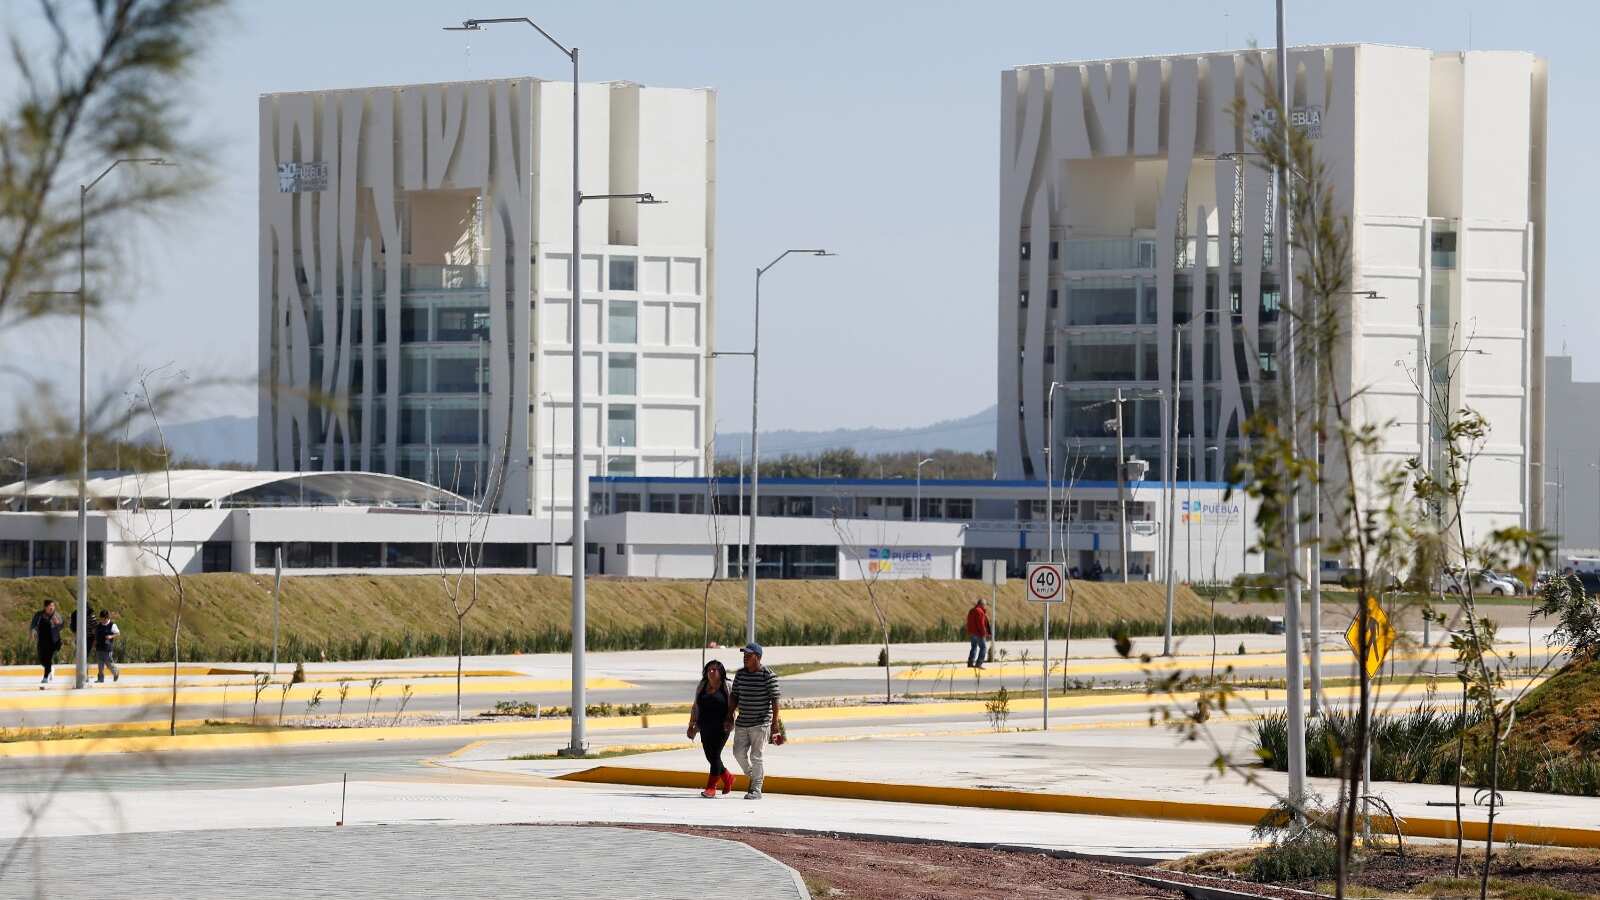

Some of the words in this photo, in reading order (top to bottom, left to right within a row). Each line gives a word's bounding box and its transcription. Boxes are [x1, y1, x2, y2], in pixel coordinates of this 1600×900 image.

[1285, 112, 1320, 125] EBLA
[1203, 504, 1239, 513] PUEBLA
[892, 551, 932, 561] PUEBLA
[1037, 572, 1054, 586] 40
